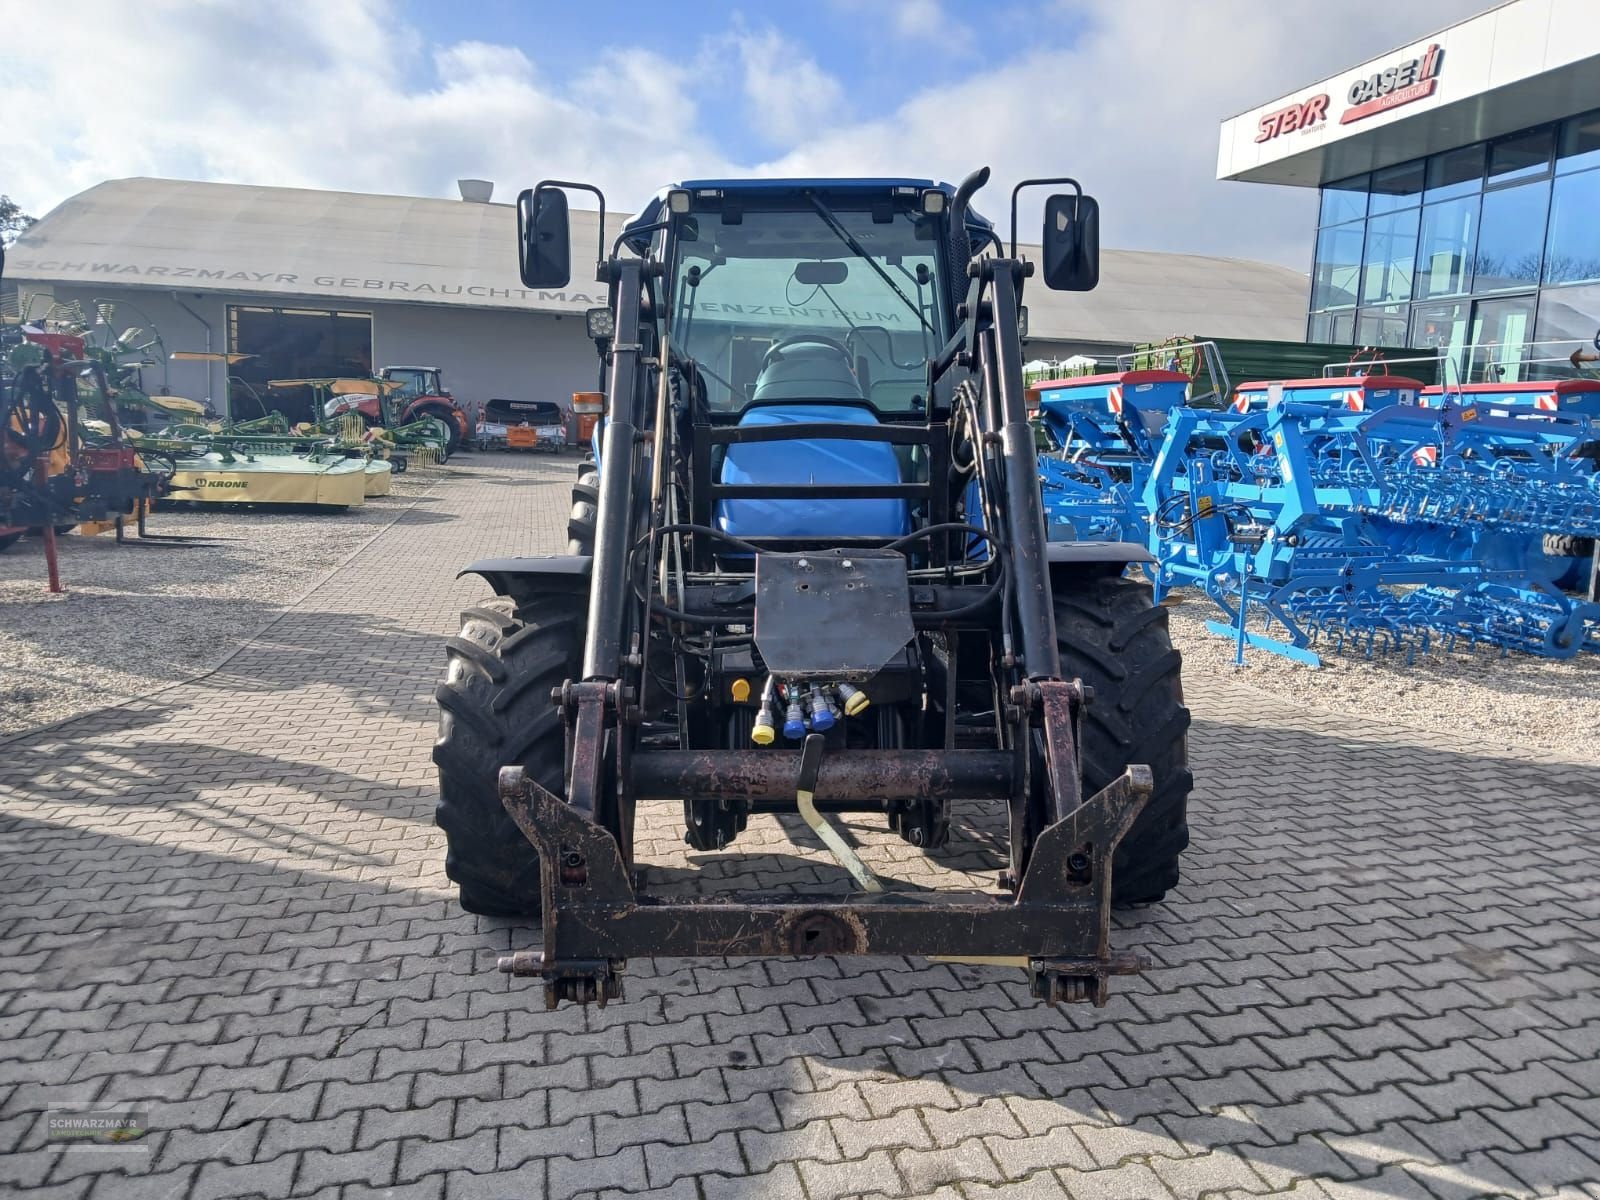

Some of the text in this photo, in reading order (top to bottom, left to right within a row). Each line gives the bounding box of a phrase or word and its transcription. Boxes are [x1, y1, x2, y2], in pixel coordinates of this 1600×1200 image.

[1347, 59, 1419, 105] CASE
[1381, 84, 1430, 108] AGRICULTURE
[1254, 93, 1330, 143] STEYR
[14, 259, 298, 284] SCHWARZMAYR
[207, 480, 249, 488] KRONE
